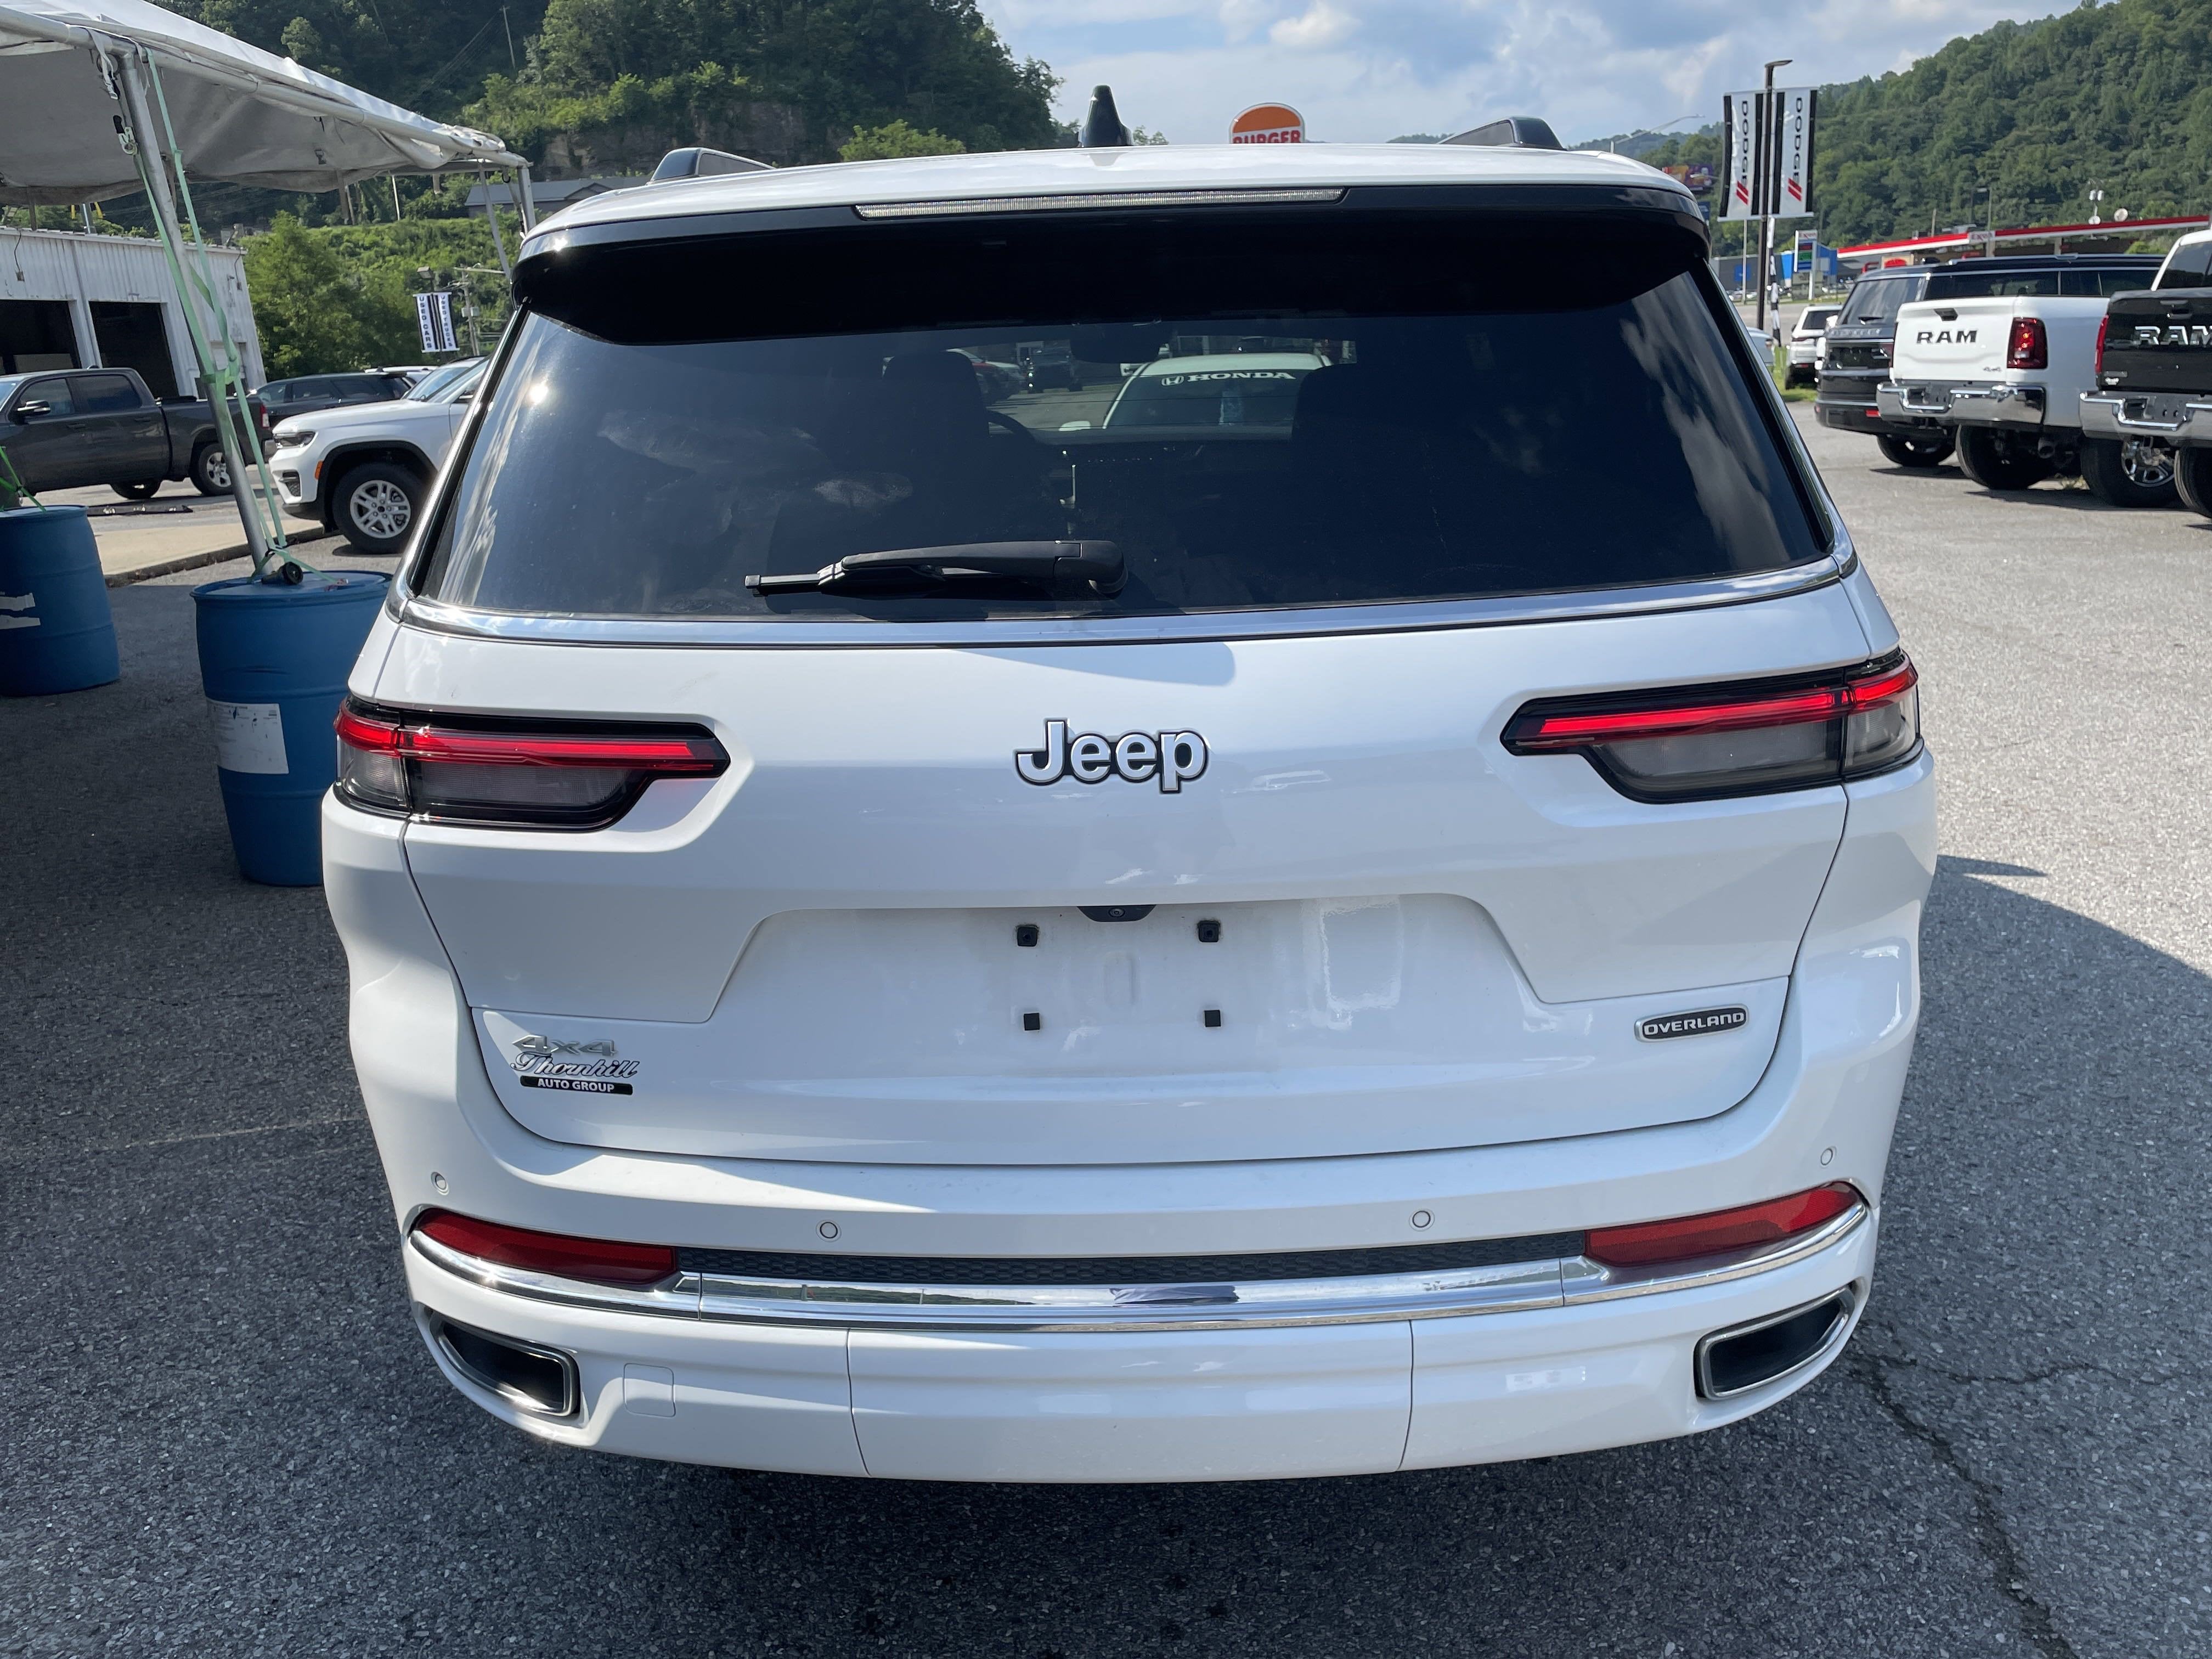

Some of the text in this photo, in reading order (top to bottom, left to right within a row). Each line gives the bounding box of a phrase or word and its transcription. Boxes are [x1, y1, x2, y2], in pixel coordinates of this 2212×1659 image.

[1793, 97, 1803, 185] DODGE
[423, 324, 432, 348] CARS
[1916, 330, 1977, 343] RAM
[2132, 326, 2212, 346] RAM
[1187, 372, 1296, 382] HONDA
[1014, 718, 1210, 794] Jeep
[1644, 1012, 1744, 1035] OVERLAND
[512, 1034, 618, 1056] 4x4
[510, 1051, 640, 1078] Thornhill
[537, 1078, 615, 1093] AUTO GROUP
